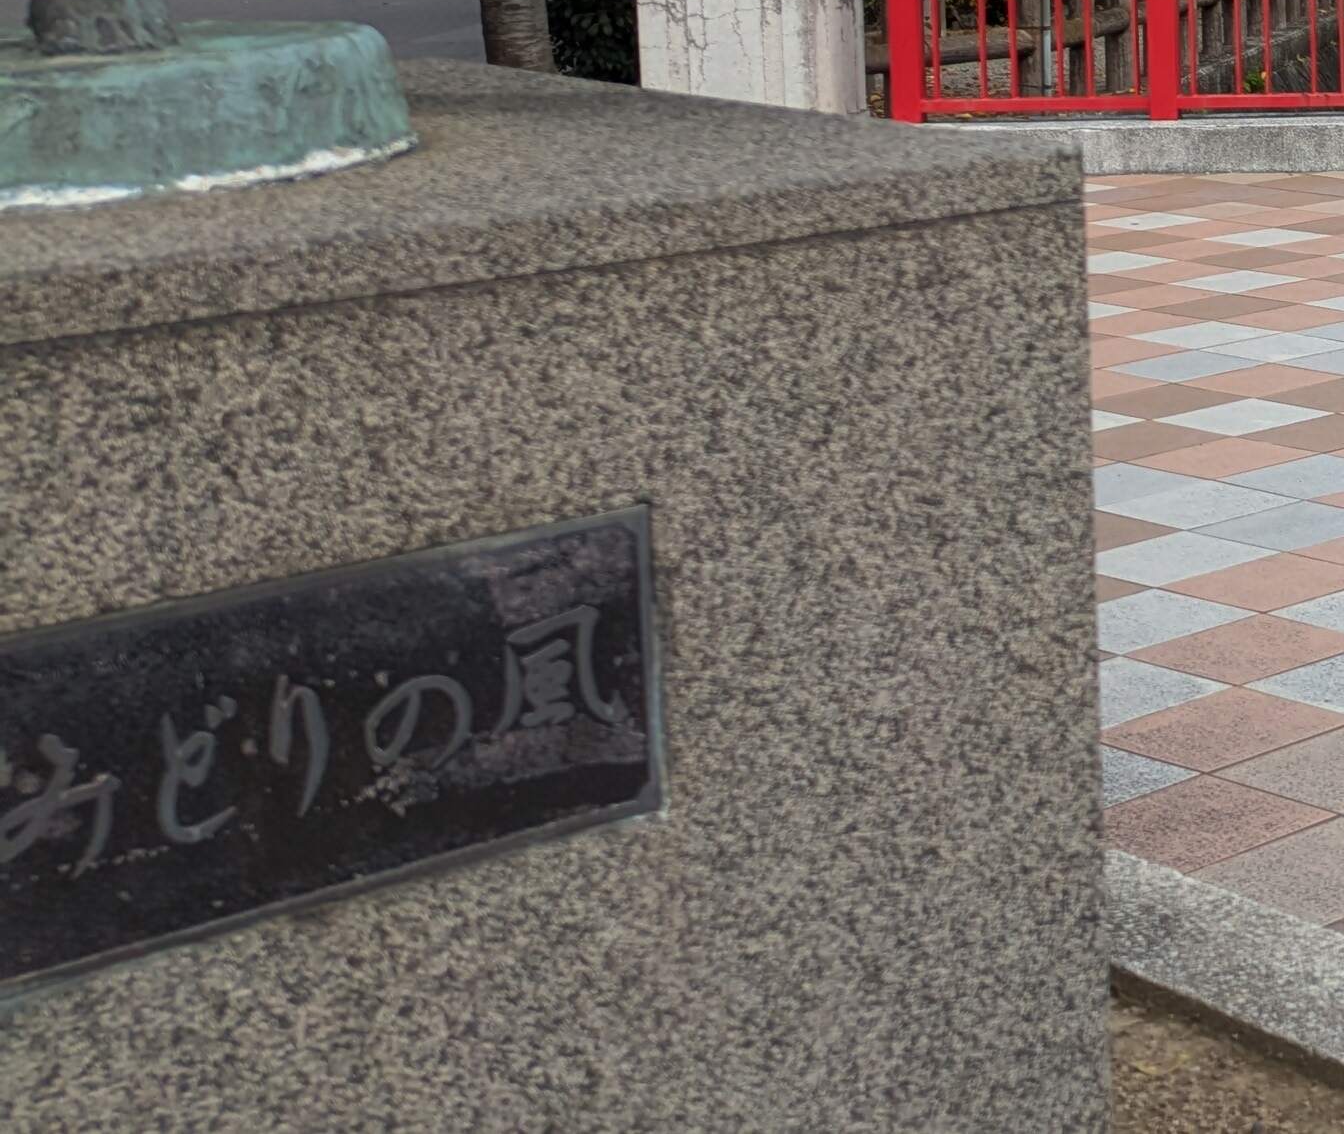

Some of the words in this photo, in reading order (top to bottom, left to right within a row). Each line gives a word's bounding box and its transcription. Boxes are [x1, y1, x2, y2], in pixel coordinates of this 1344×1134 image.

[0, 603, 630, 880] みどりの風
